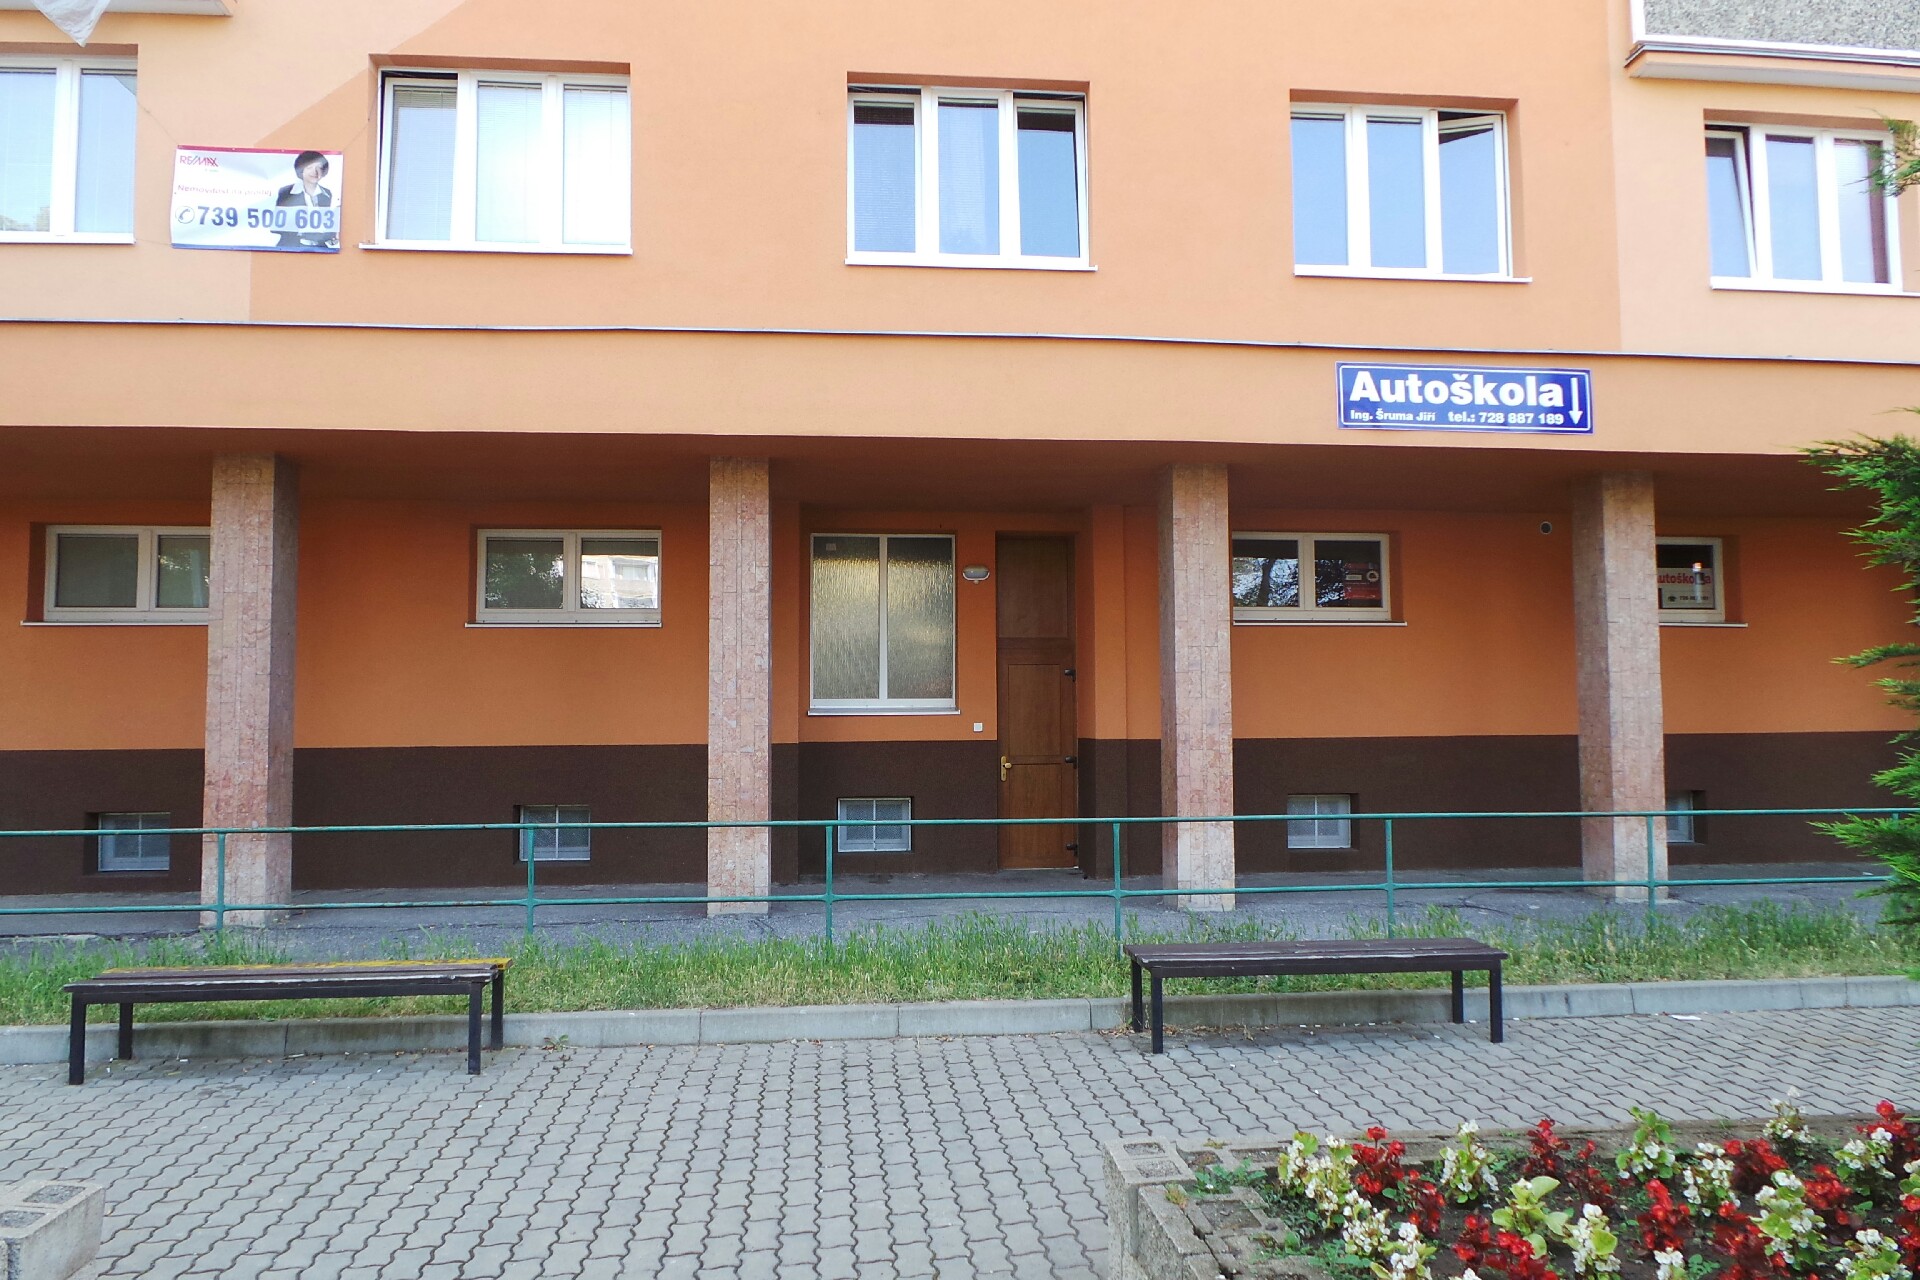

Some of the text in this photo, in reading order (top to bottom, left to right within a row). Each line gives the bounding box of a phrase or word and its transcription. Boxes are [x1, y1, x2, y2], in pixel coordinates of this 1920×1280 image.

[179, 155, 219, 168] RE/MAX
[197, 205, 335, 229] 739 500 603
[1350, 370, 1565, 408] Autoškola
[1350, 408, 1564, 425] Ing. Šruma Jiří tel.: 728 887 189
[1657, 572, 1712, 585] utoškoa
